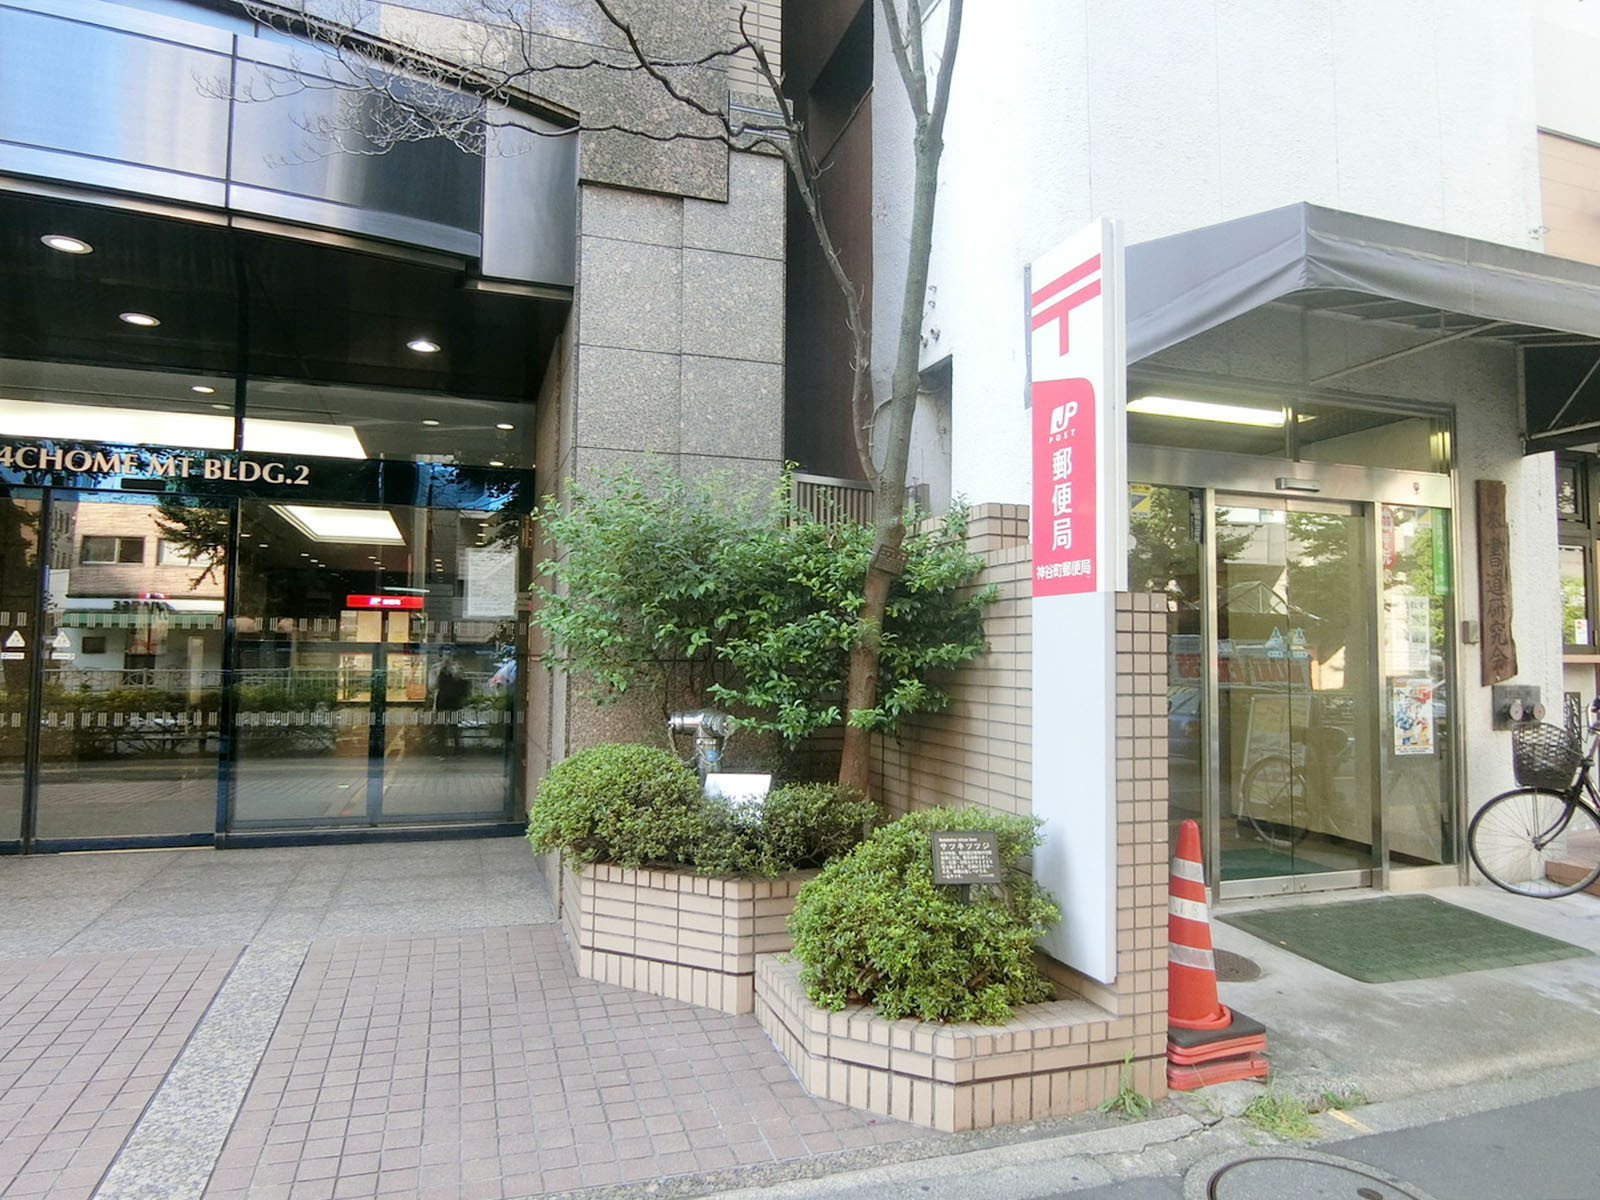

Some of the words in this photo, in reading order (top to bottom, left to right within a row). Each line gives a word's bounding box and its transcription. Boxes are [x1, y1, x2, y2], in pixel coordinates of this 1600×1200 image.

[1048, 429, 1076, 444] POST
[0, 446, 138, 474] 4CHOME
[148, 454, 194, 478] MT
[204, 459, 309, 485] BLDG.2
[1052, 447, 1072, 551] 郵便局
[1036, 559, 1091, 579] 神谷町郵便局
